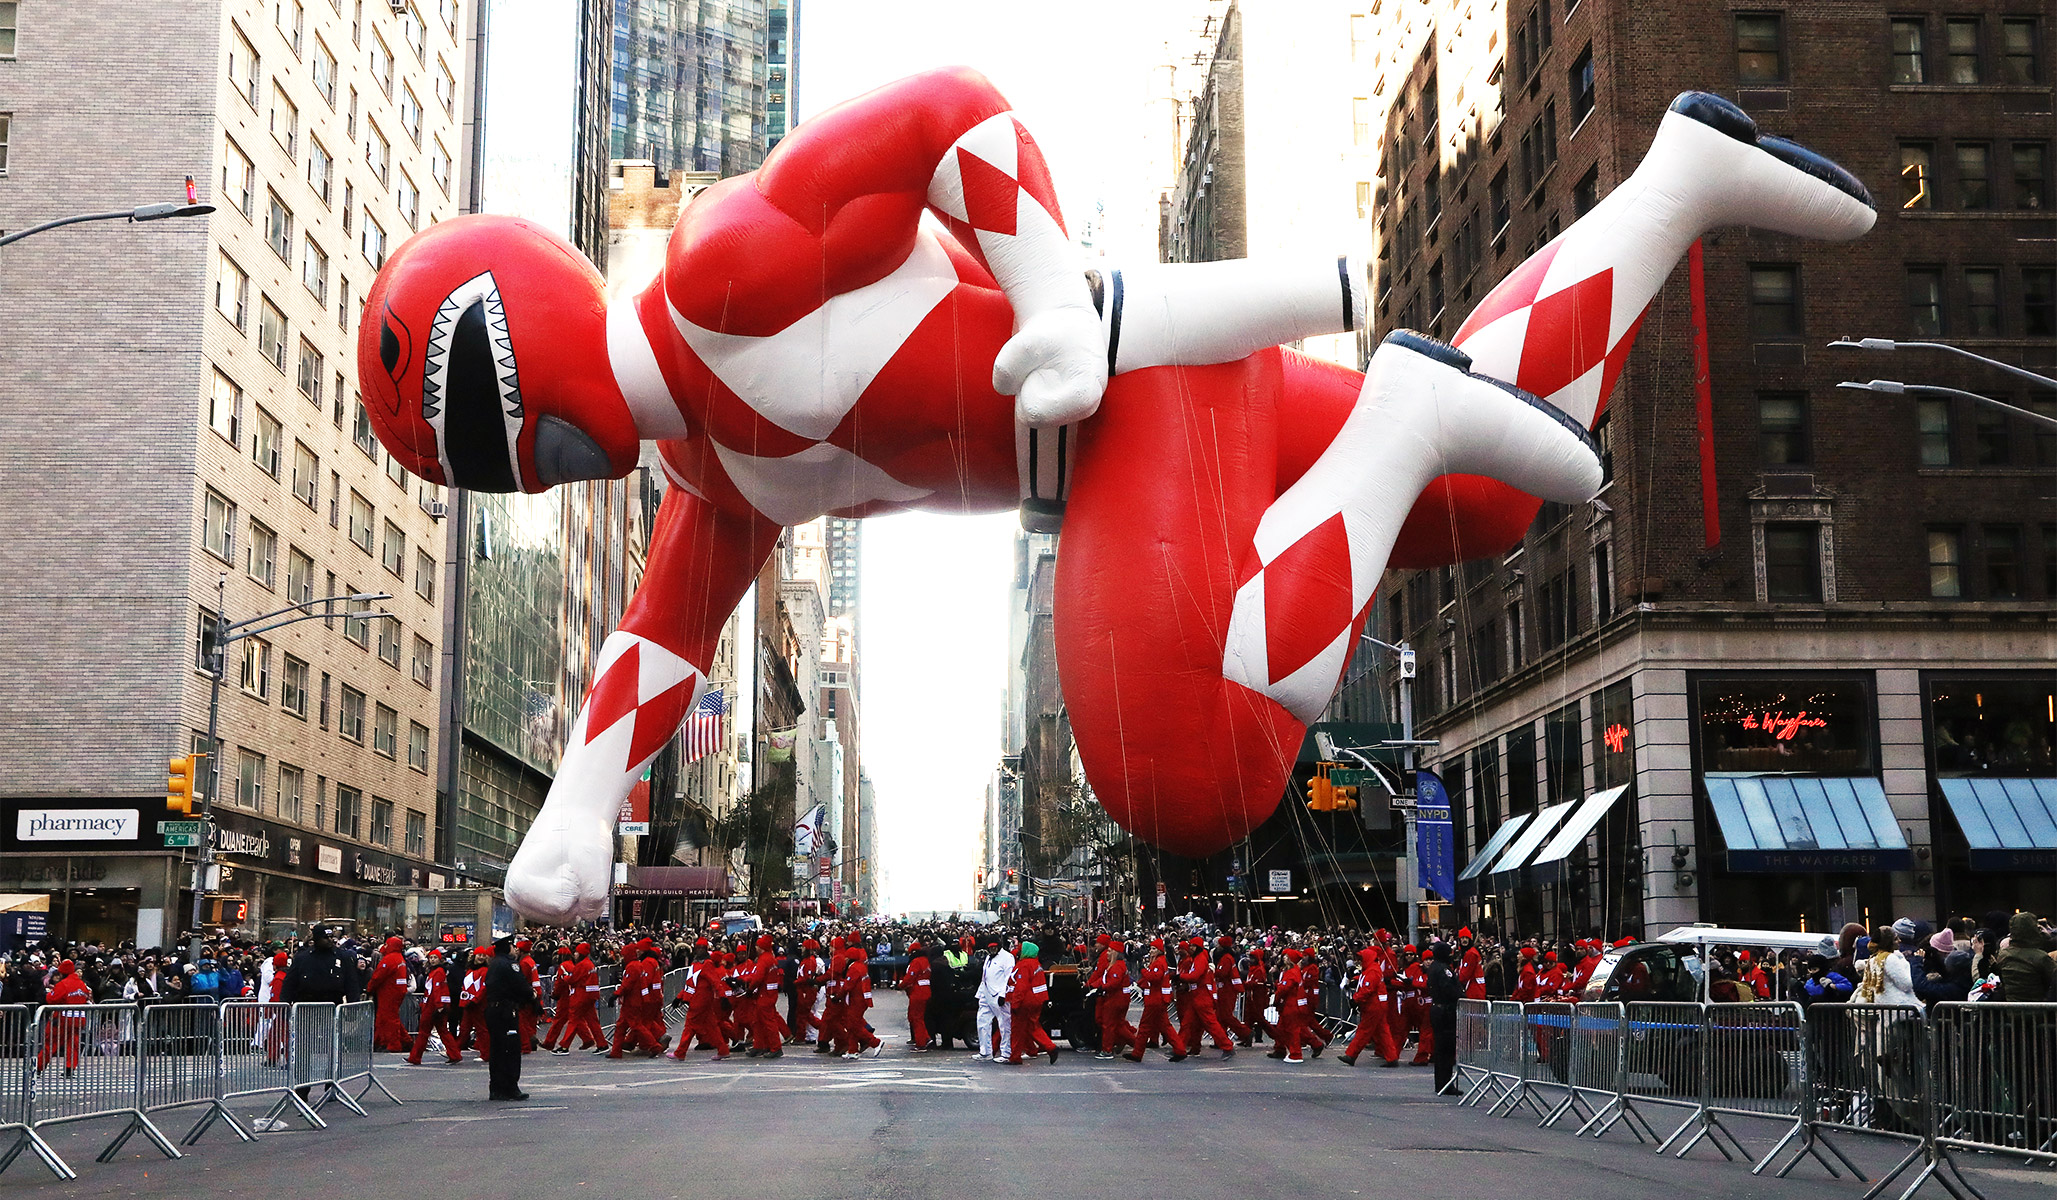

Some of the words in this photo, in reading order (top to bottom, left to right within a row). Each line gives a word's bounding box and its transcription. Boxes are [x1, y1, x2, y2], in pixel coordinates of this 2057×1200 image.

[1741, 714, 1759, 730] the
[1762, 711, 1827, 740] Wayfarer
[1419, 809, 1449, 820] NYPD
[29, 813, 127, 836] pharmacy
[168, 836, 175, 845] 6
[1764, 855, 1790, 866] THE
[1798, 855, 1876, 866] WAYFARER
[237, 903, 246, 920] 2
